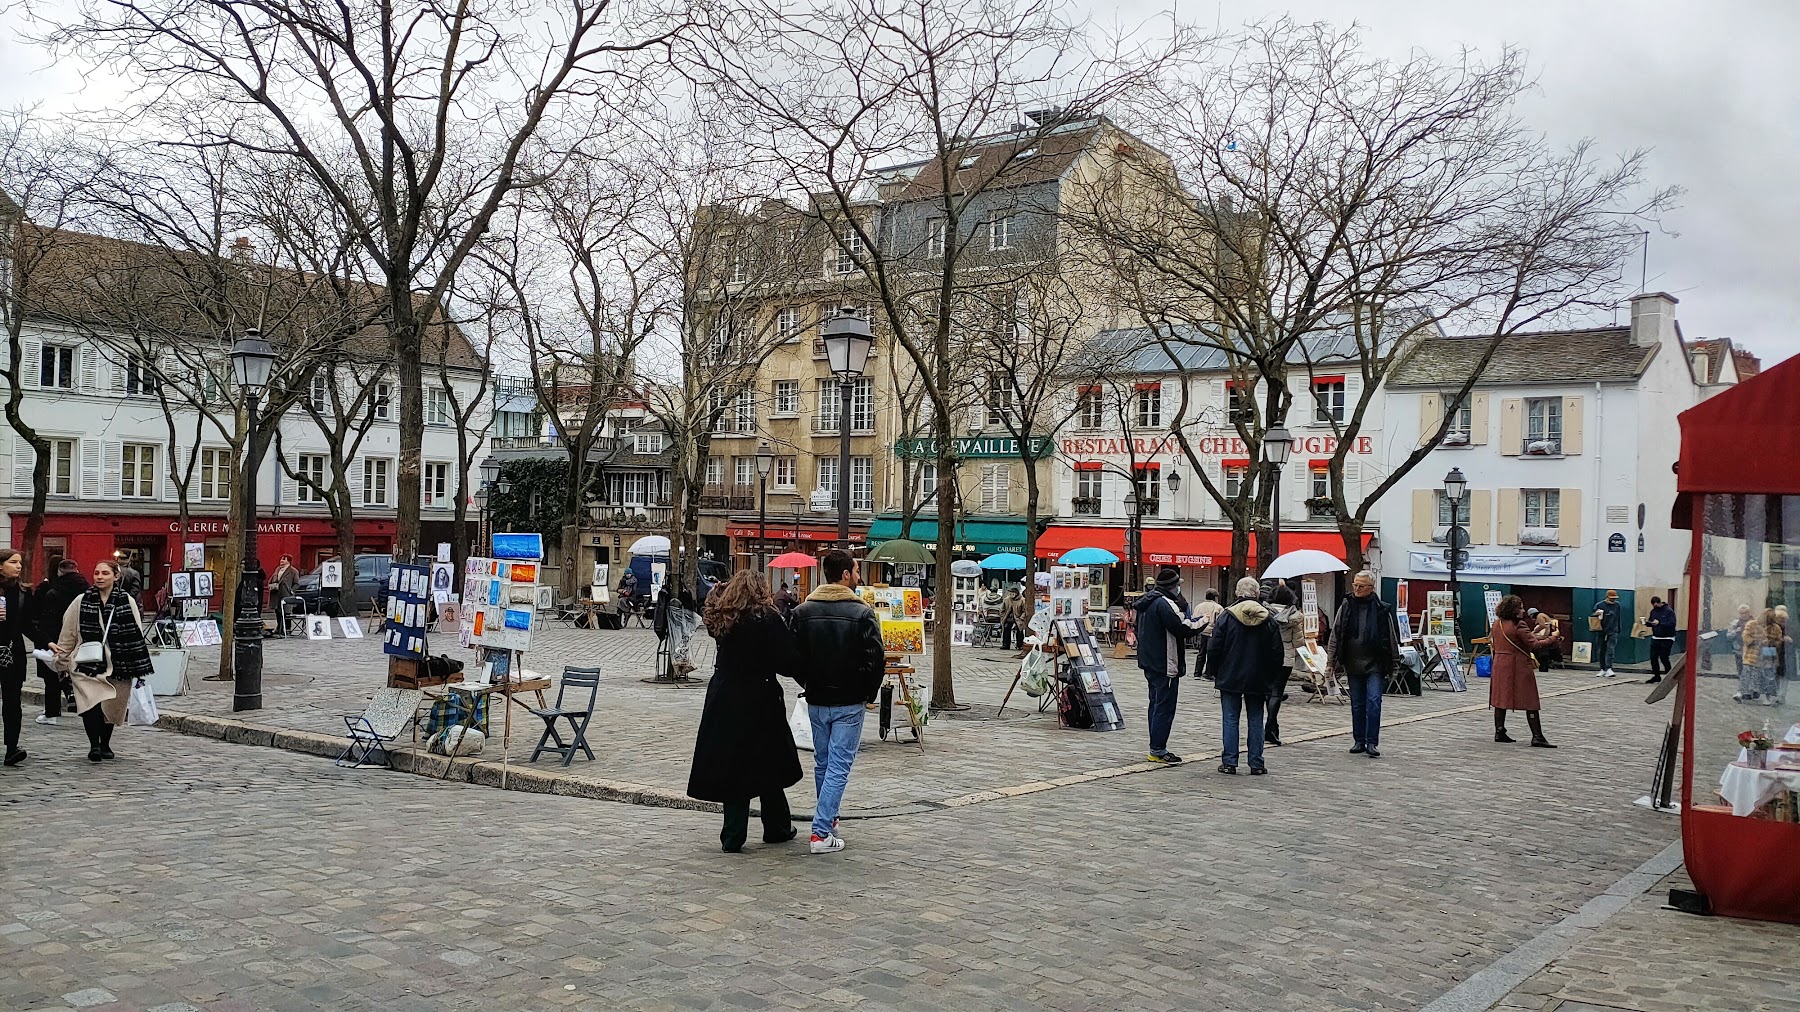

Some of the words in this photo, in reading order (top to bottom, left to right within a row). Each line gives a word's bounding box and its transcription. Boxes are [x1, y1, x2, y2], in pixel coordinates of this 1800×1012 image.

[930, 439, 1041, 454] CEMAILLEE
[1199, 437, 1256, 455] CHE
[1270, 433, 1373, 455] UGÈE
[169, 522, 218, 532] GLERIE
[222, 522, 301, 533] MMARTRE
